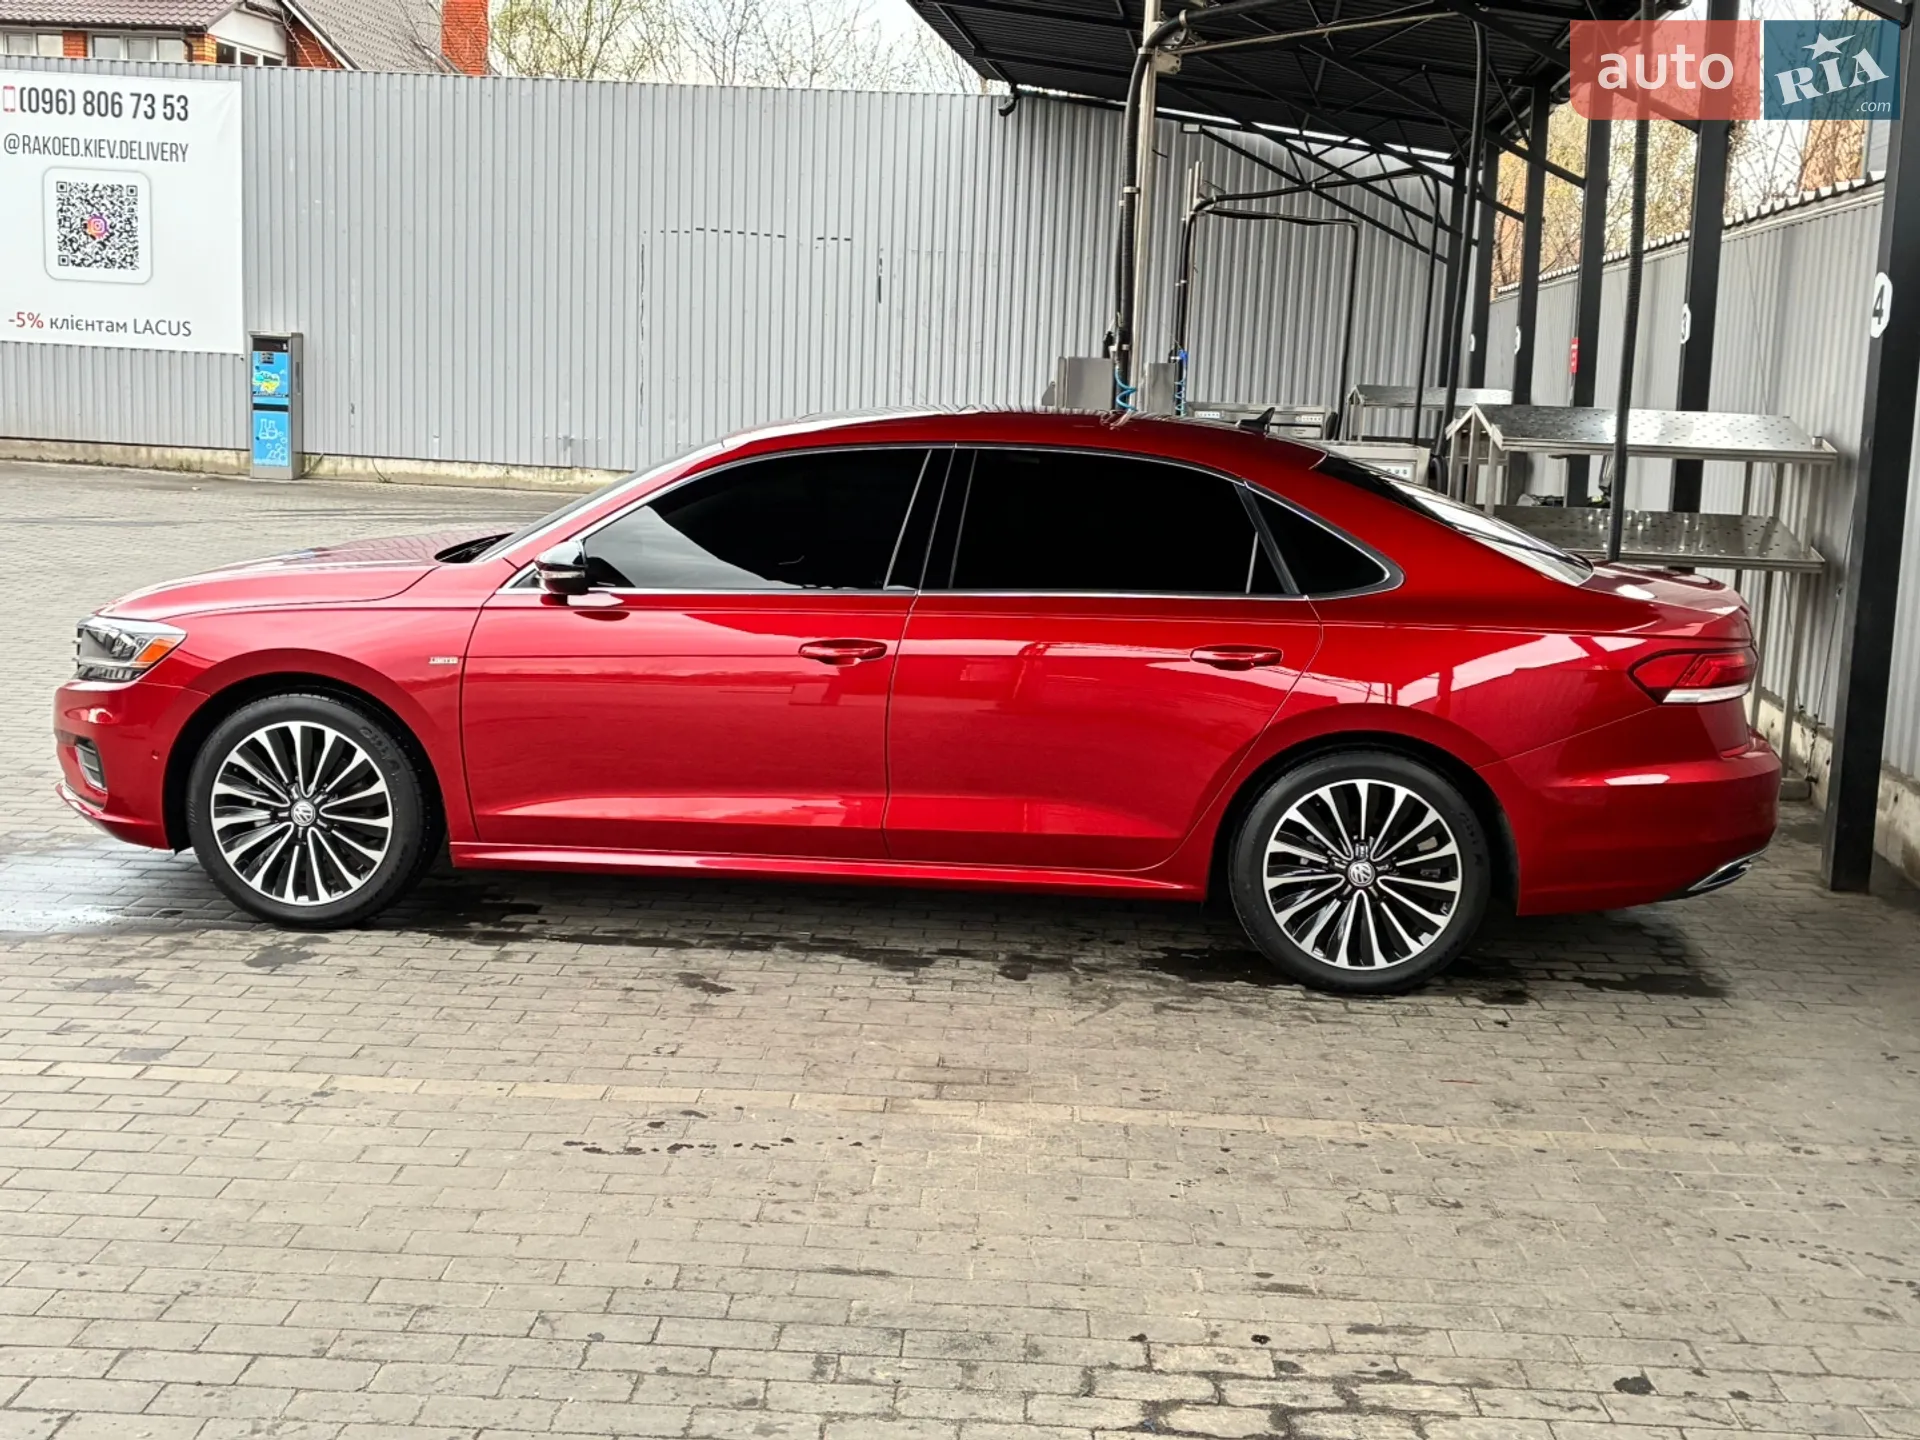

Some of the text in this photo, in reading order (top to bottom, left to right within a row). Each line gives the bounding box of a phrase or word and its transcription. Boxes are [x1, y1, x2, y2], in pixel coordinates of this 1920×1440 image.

[19, 87, 189, 121] (096) 806 73 53
[3, 133, 189, 162] @RAKOED.KIEV.DELIVERY
[1872, 284, 1885, 325] 4
[8, 311, 192, 337] -5% клієнтам LACUS
